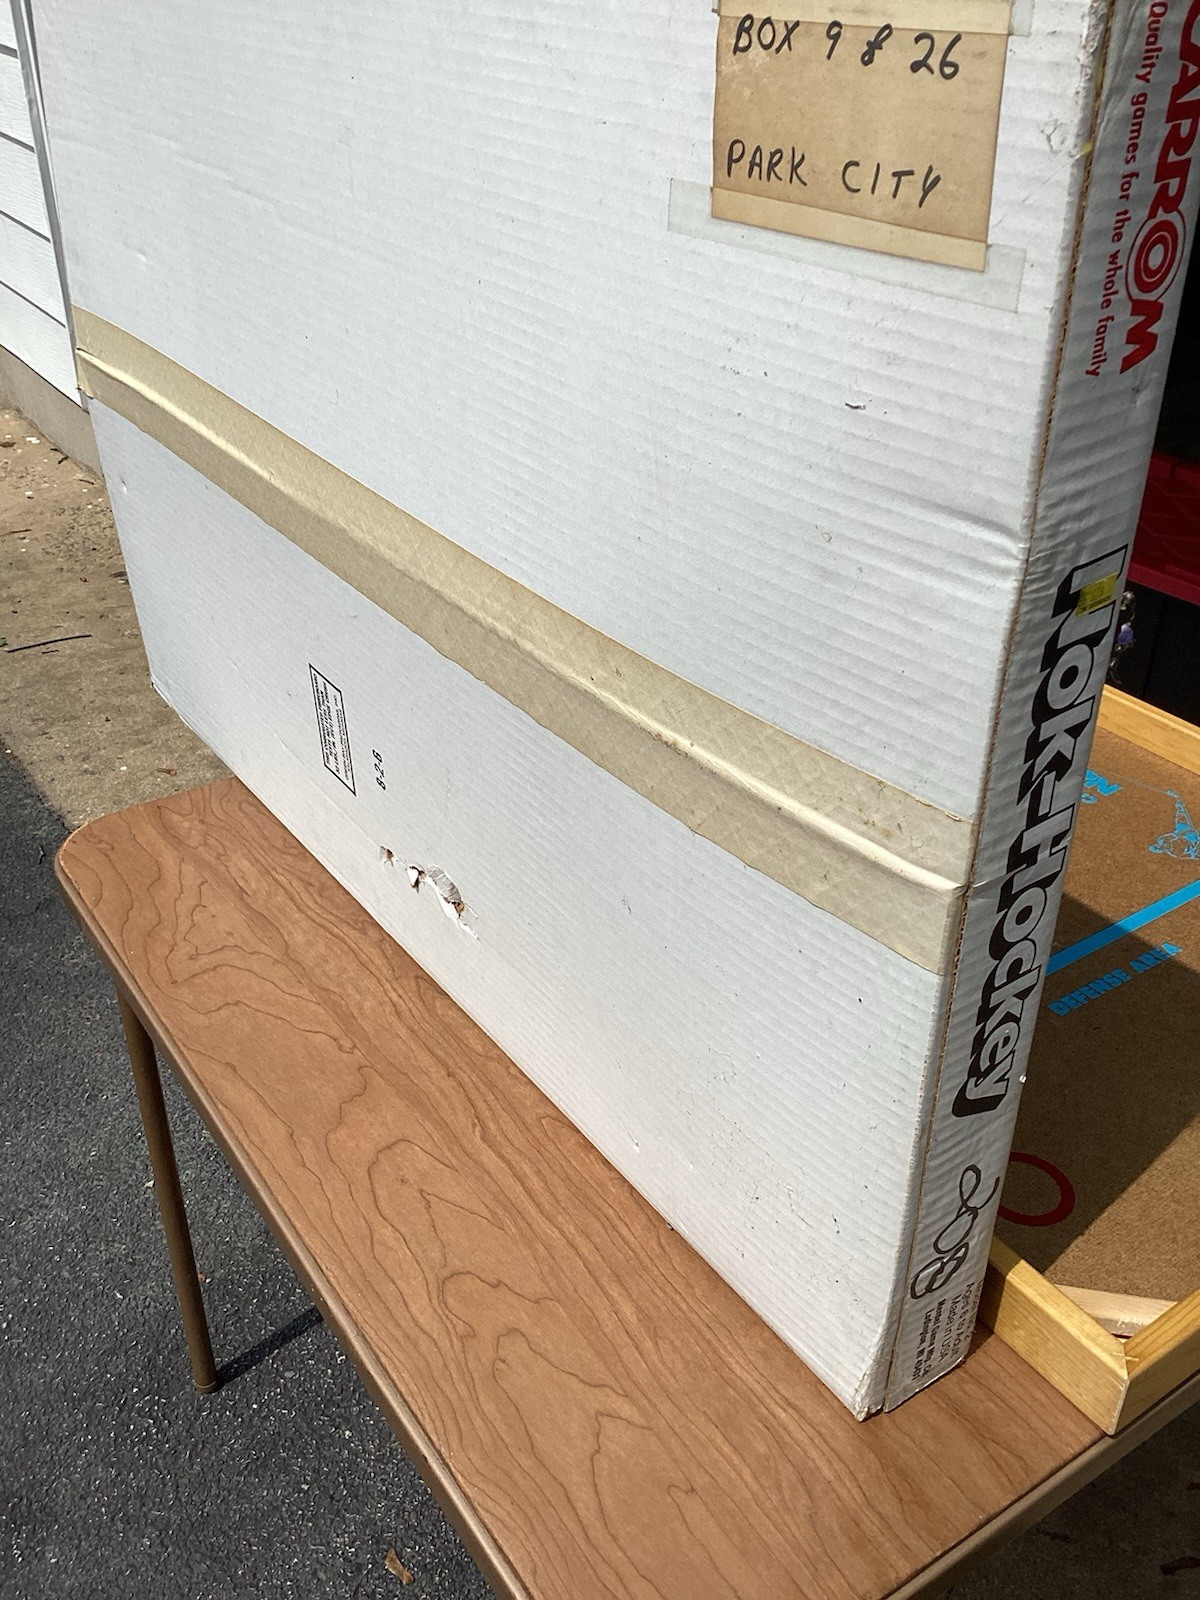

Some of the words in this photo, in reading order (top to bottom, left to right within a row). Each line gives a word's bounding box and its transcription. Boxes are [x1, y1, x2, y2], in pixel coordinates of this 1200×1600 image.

[733, 13, 800, 56] BOX
[826, 20, 843, 60] 9
[909, 32, 962, 80] 26
[1135, 1, 1168, 84] Quality
[1125, 92, 1148, 166] games
[727, 138, 808, 187] PARK
[841, 160, 942, 208] CITY
[1119, 171, 1139, 202] for
[1111, 209, 1131, 244] the
[1101, 249, 1123, 310] whole
[1085, 315, 1114, 377] family
[951, 543, 1128, 1118] Nok-Hockey
[1047, 967, 1133, 1017] DEFENSE
[1129, 941, 1183, 975] AREA
[946, 1294, 961, 1325] Made
[962, 1282, 975, 1309] Ages
[939, 1336, 952, 1362] USA
[944, 1324, 954, 1337] in
